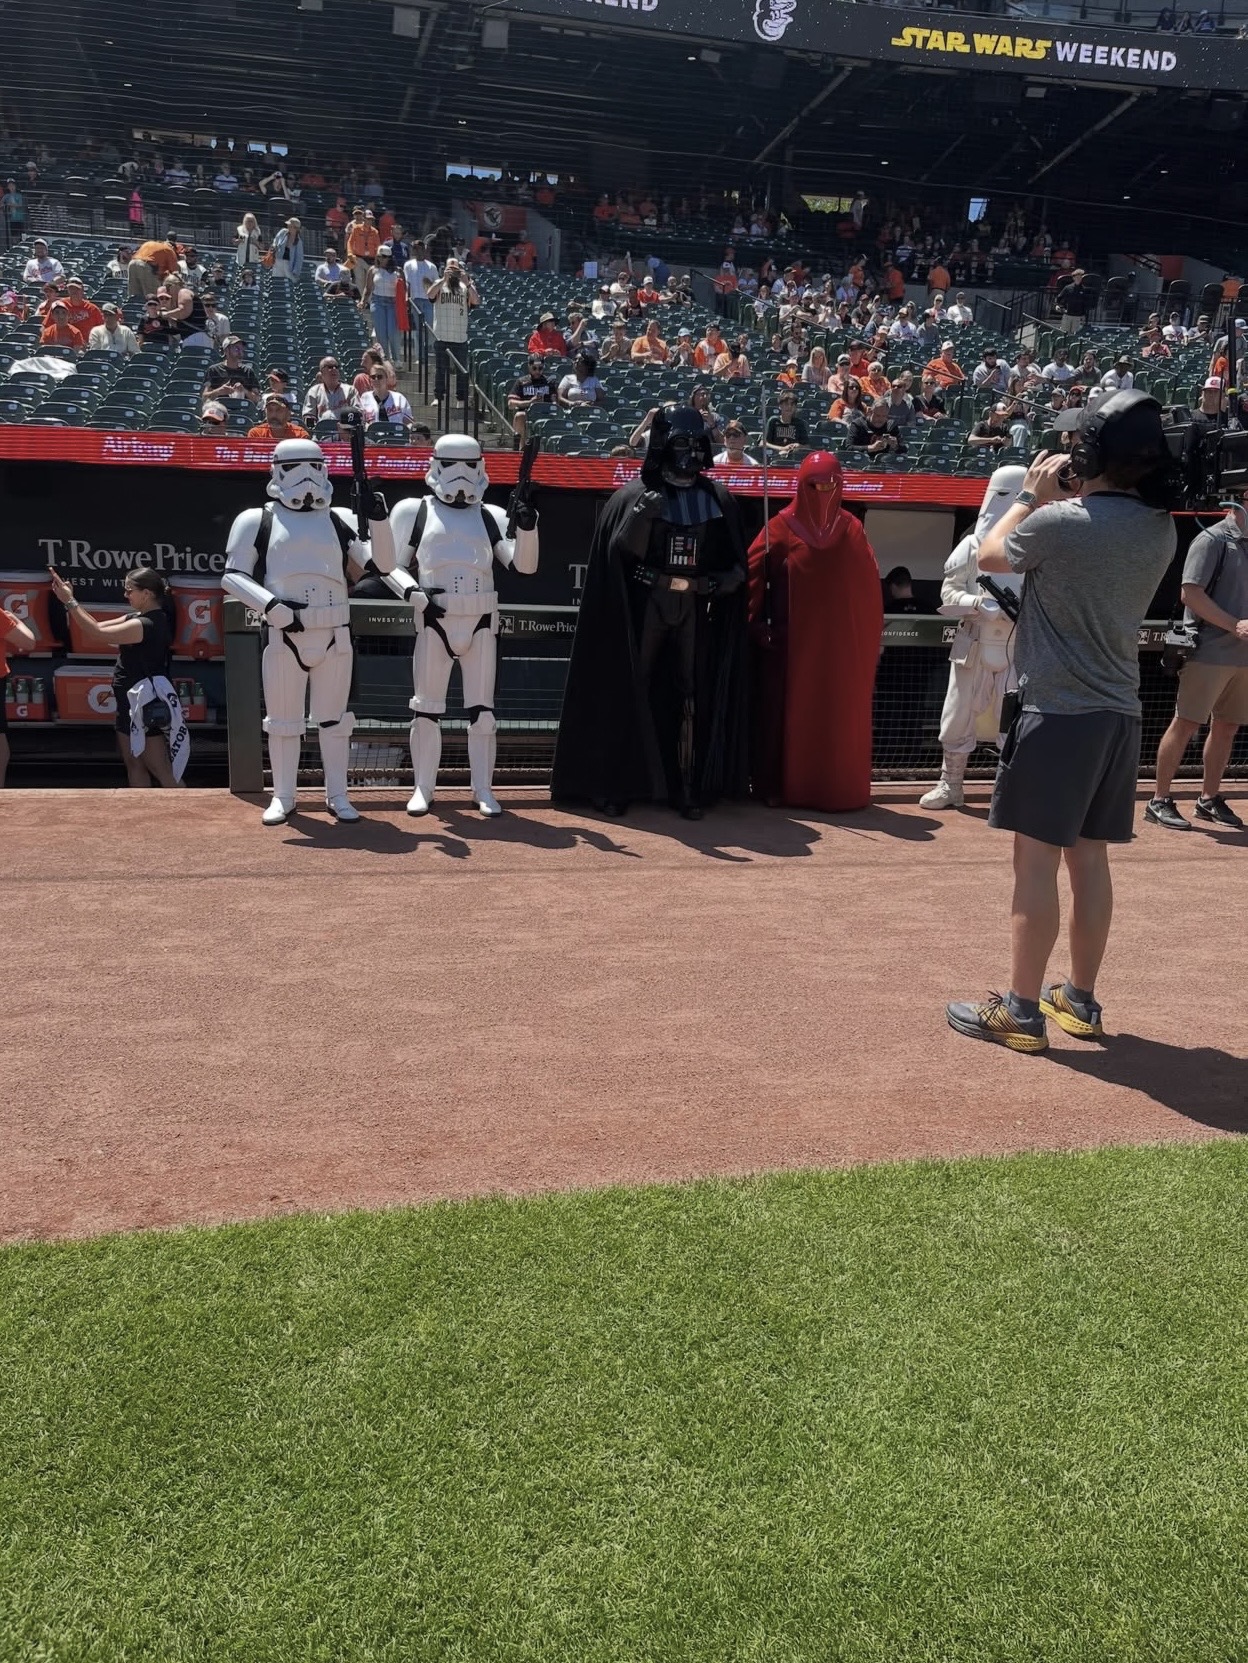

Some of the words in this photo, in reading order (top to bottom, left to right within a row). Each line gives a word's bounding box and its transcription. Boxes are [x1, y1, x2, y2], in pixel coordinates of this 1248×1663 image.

[891, 26, 970, 53] STAR
[973, 33, 1053, 60] WARS
[1056, 41, 1177, 71] WEEKEND
[188, 600, 211, 624] G
[16, 705, 28, 717] G
[88, 684, 117, 713] G
